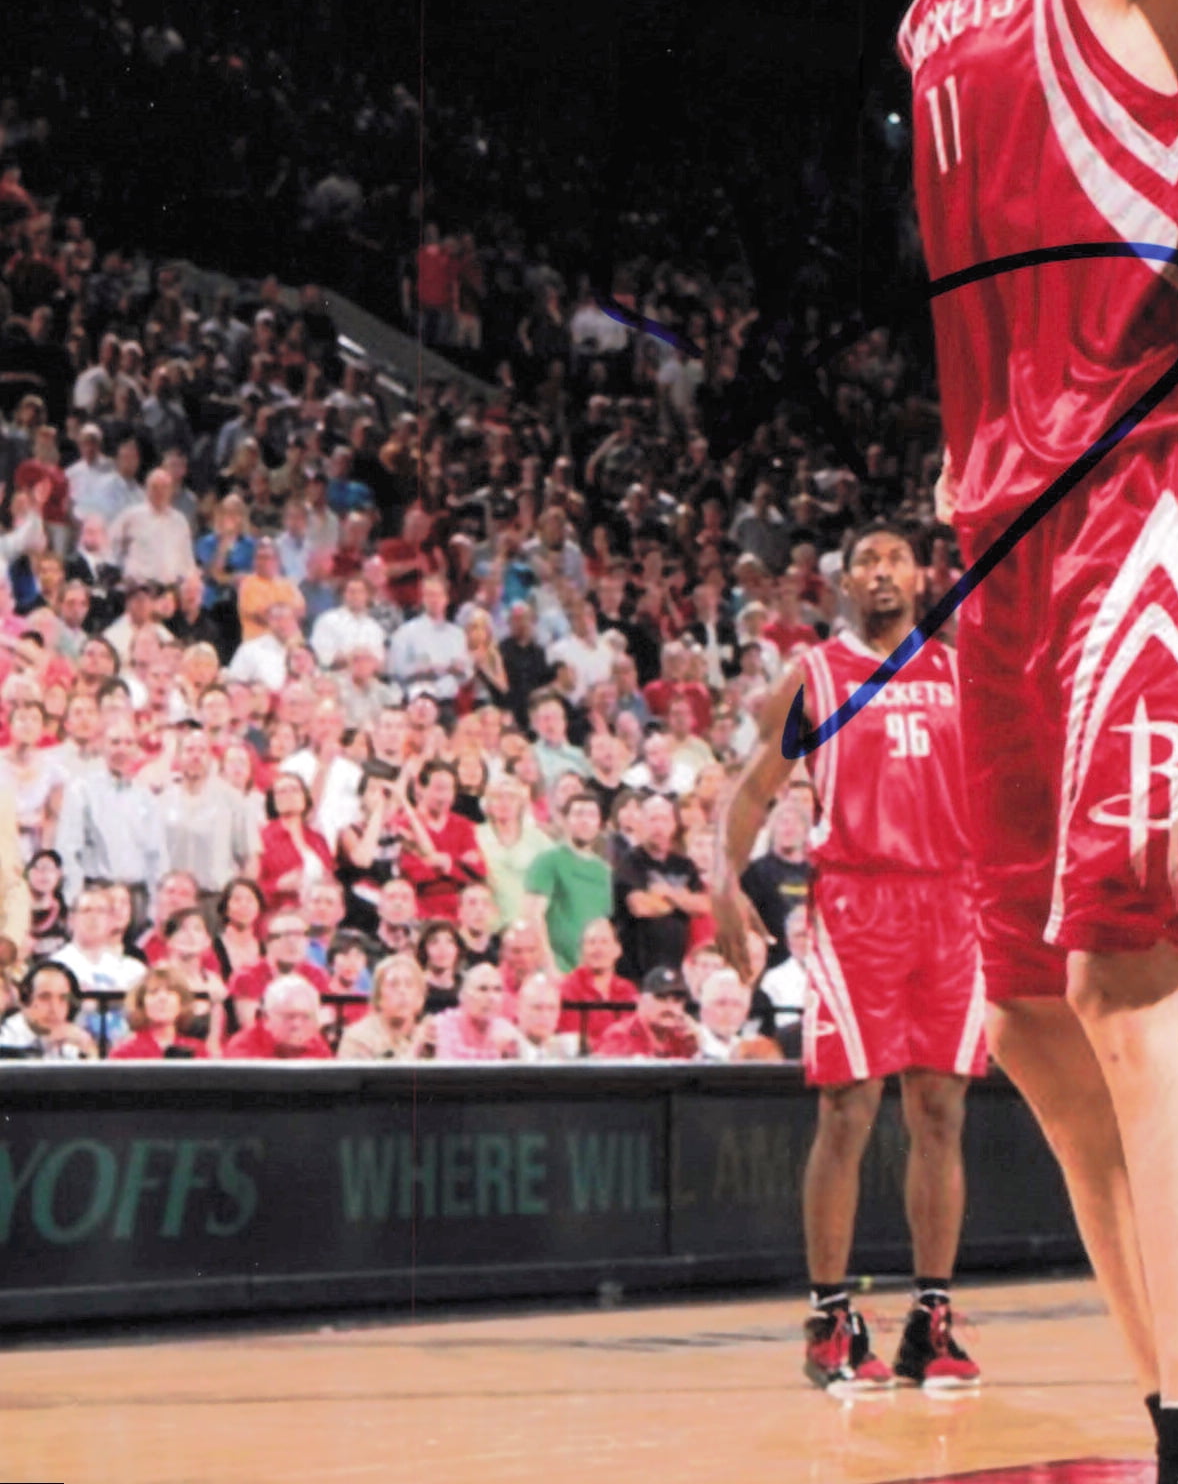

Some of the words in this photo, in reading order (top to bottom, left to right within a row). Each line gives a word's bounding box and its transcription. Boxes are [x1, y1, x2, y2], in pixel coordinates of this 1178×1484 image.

[925, 75, 963, 174] 11
[885, 711, 931, 759] 96
[338, 1131, 549, 1222] WHERE
